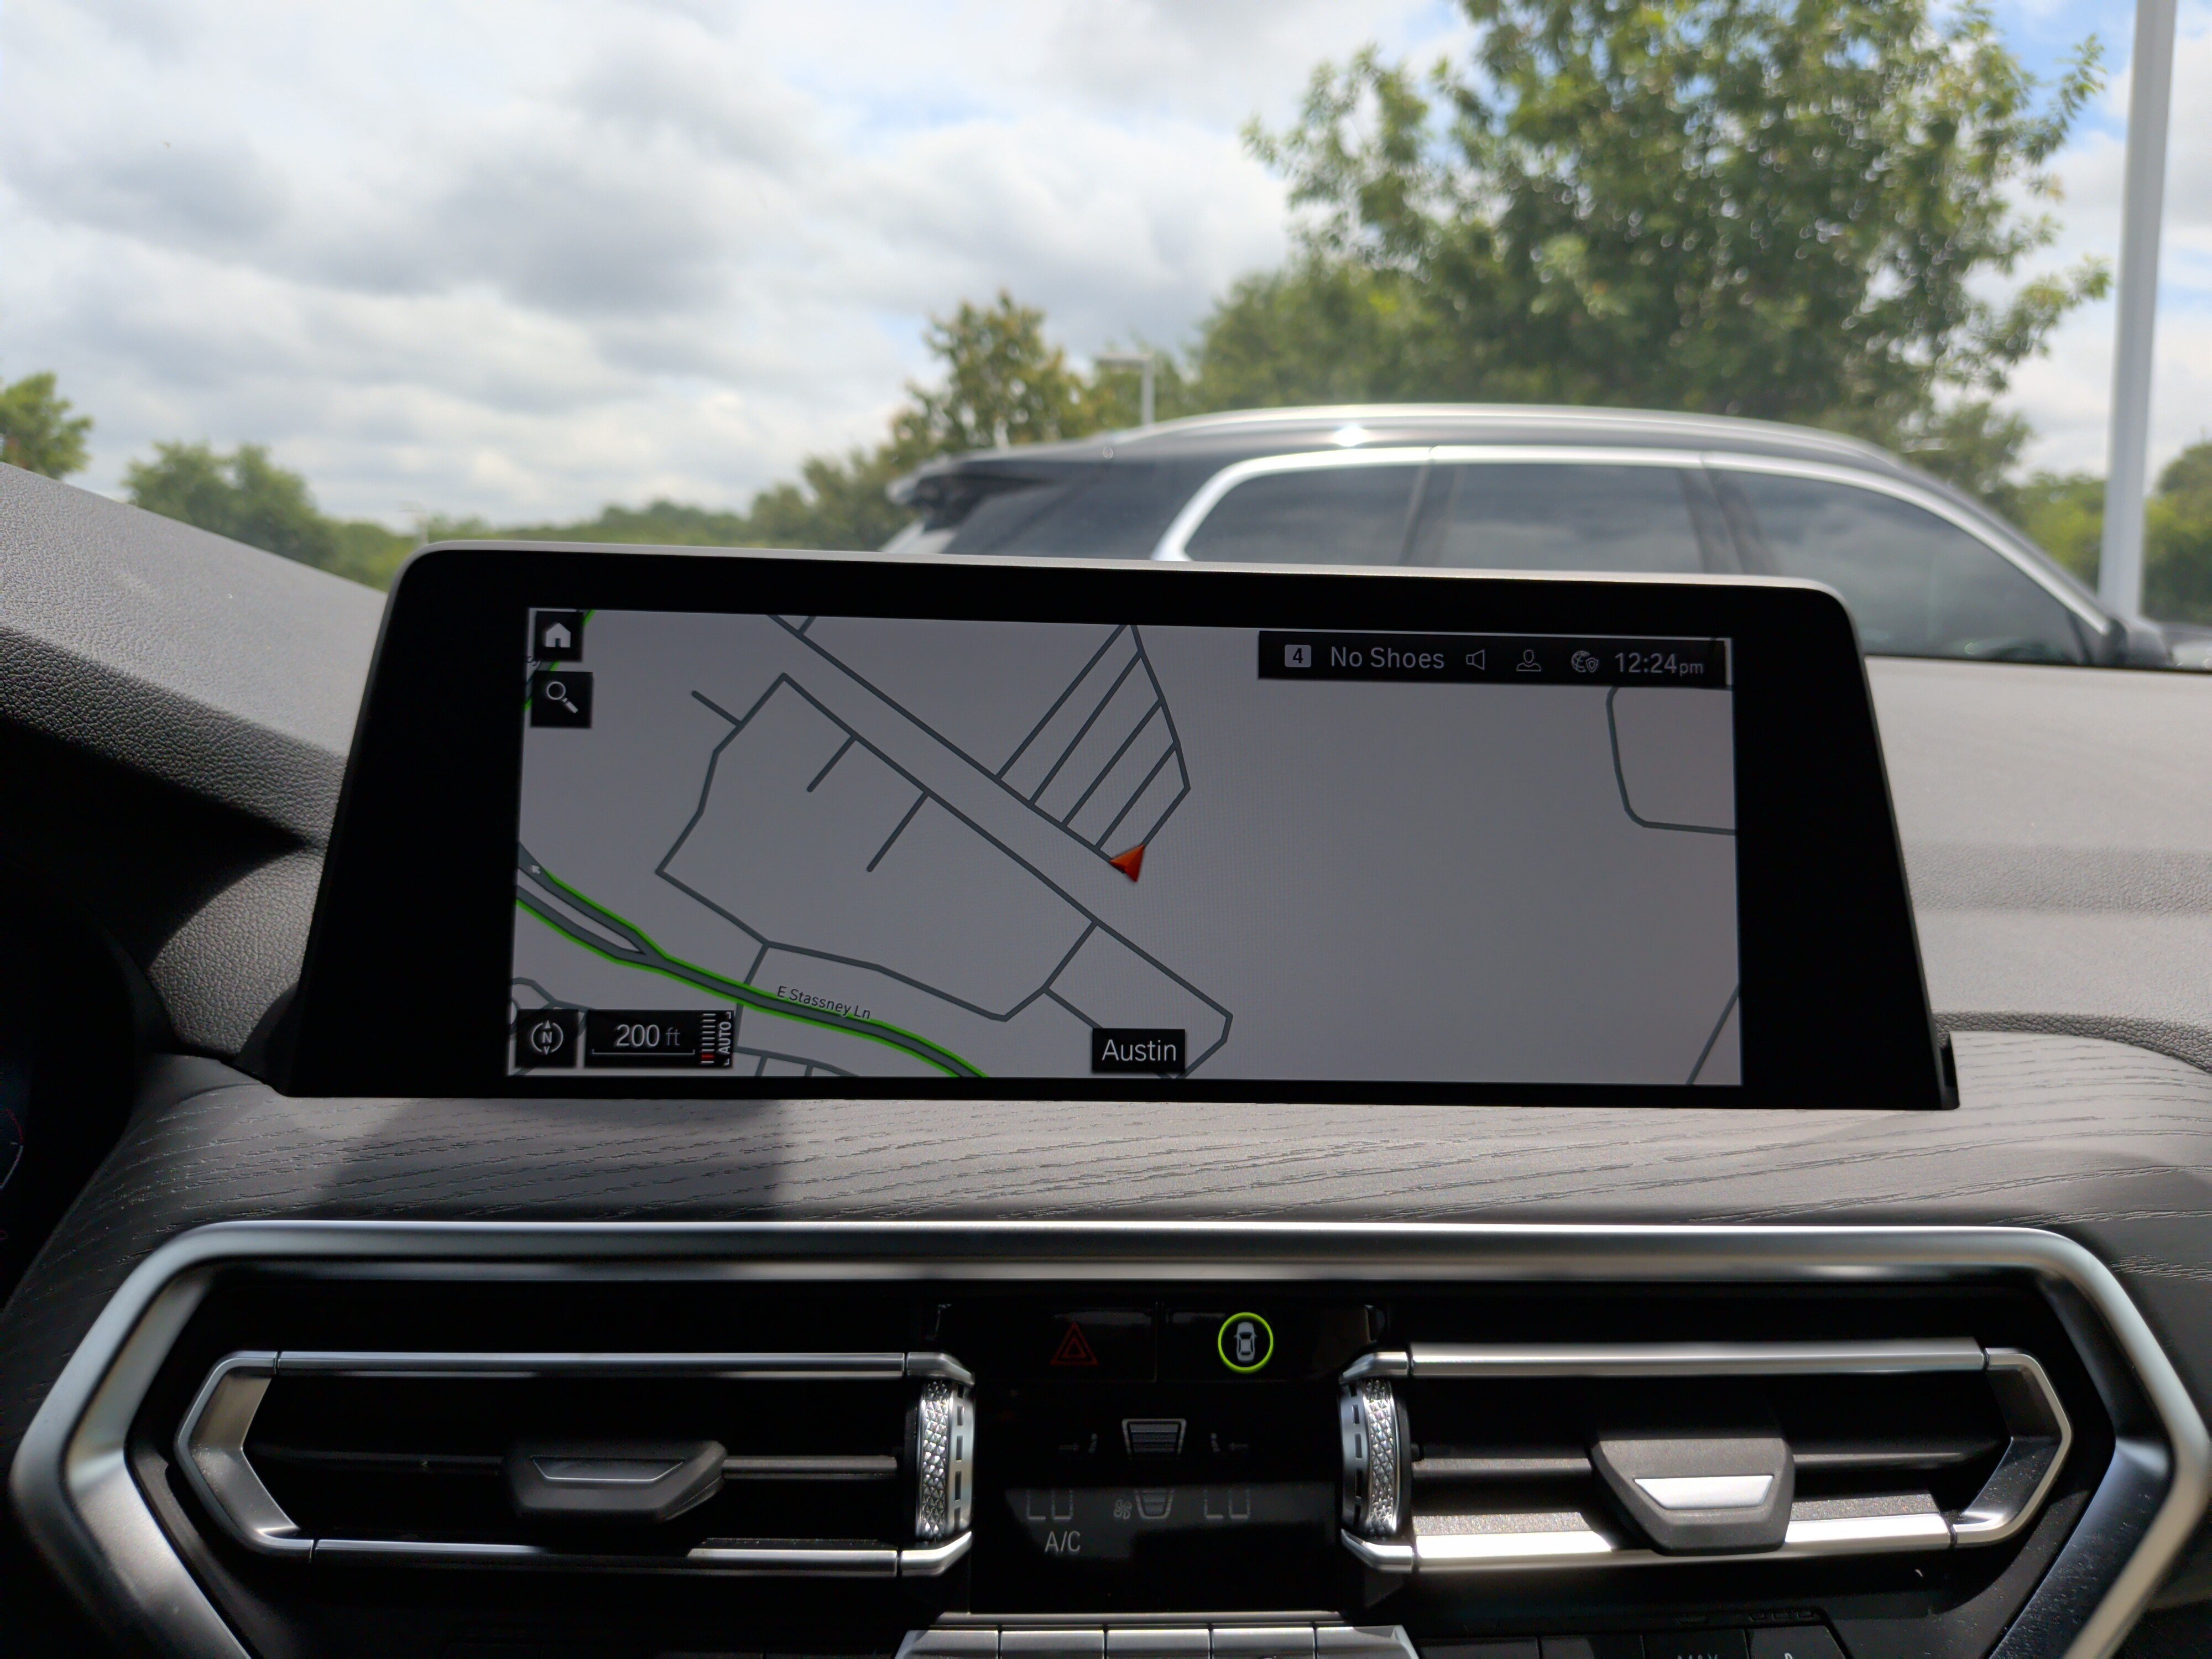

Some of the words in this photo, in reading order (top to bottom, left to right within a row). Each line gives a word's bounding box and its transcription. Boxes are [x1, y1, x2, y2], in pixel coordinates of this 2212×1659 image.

[1292, 648, 1303, 664] 4
[1331, 646, 1363, 667] No
[1370, 647, 1444, 669] Shoes
[777, 985, 787, 998] E
[789, 989, 852, 1016] Stassney
[854, 1005, 870, 1020] Ln
[541, 1032, 552, 1044] N
[615, 1024, 660, 1047] 200
[665, 1027, 681, 1046] ft
[719, 1021, 732, 1055] AUTO
[1102, 1039, 1177, 1062] Austin
[1045, 1530, 1081, 1552] A/C
